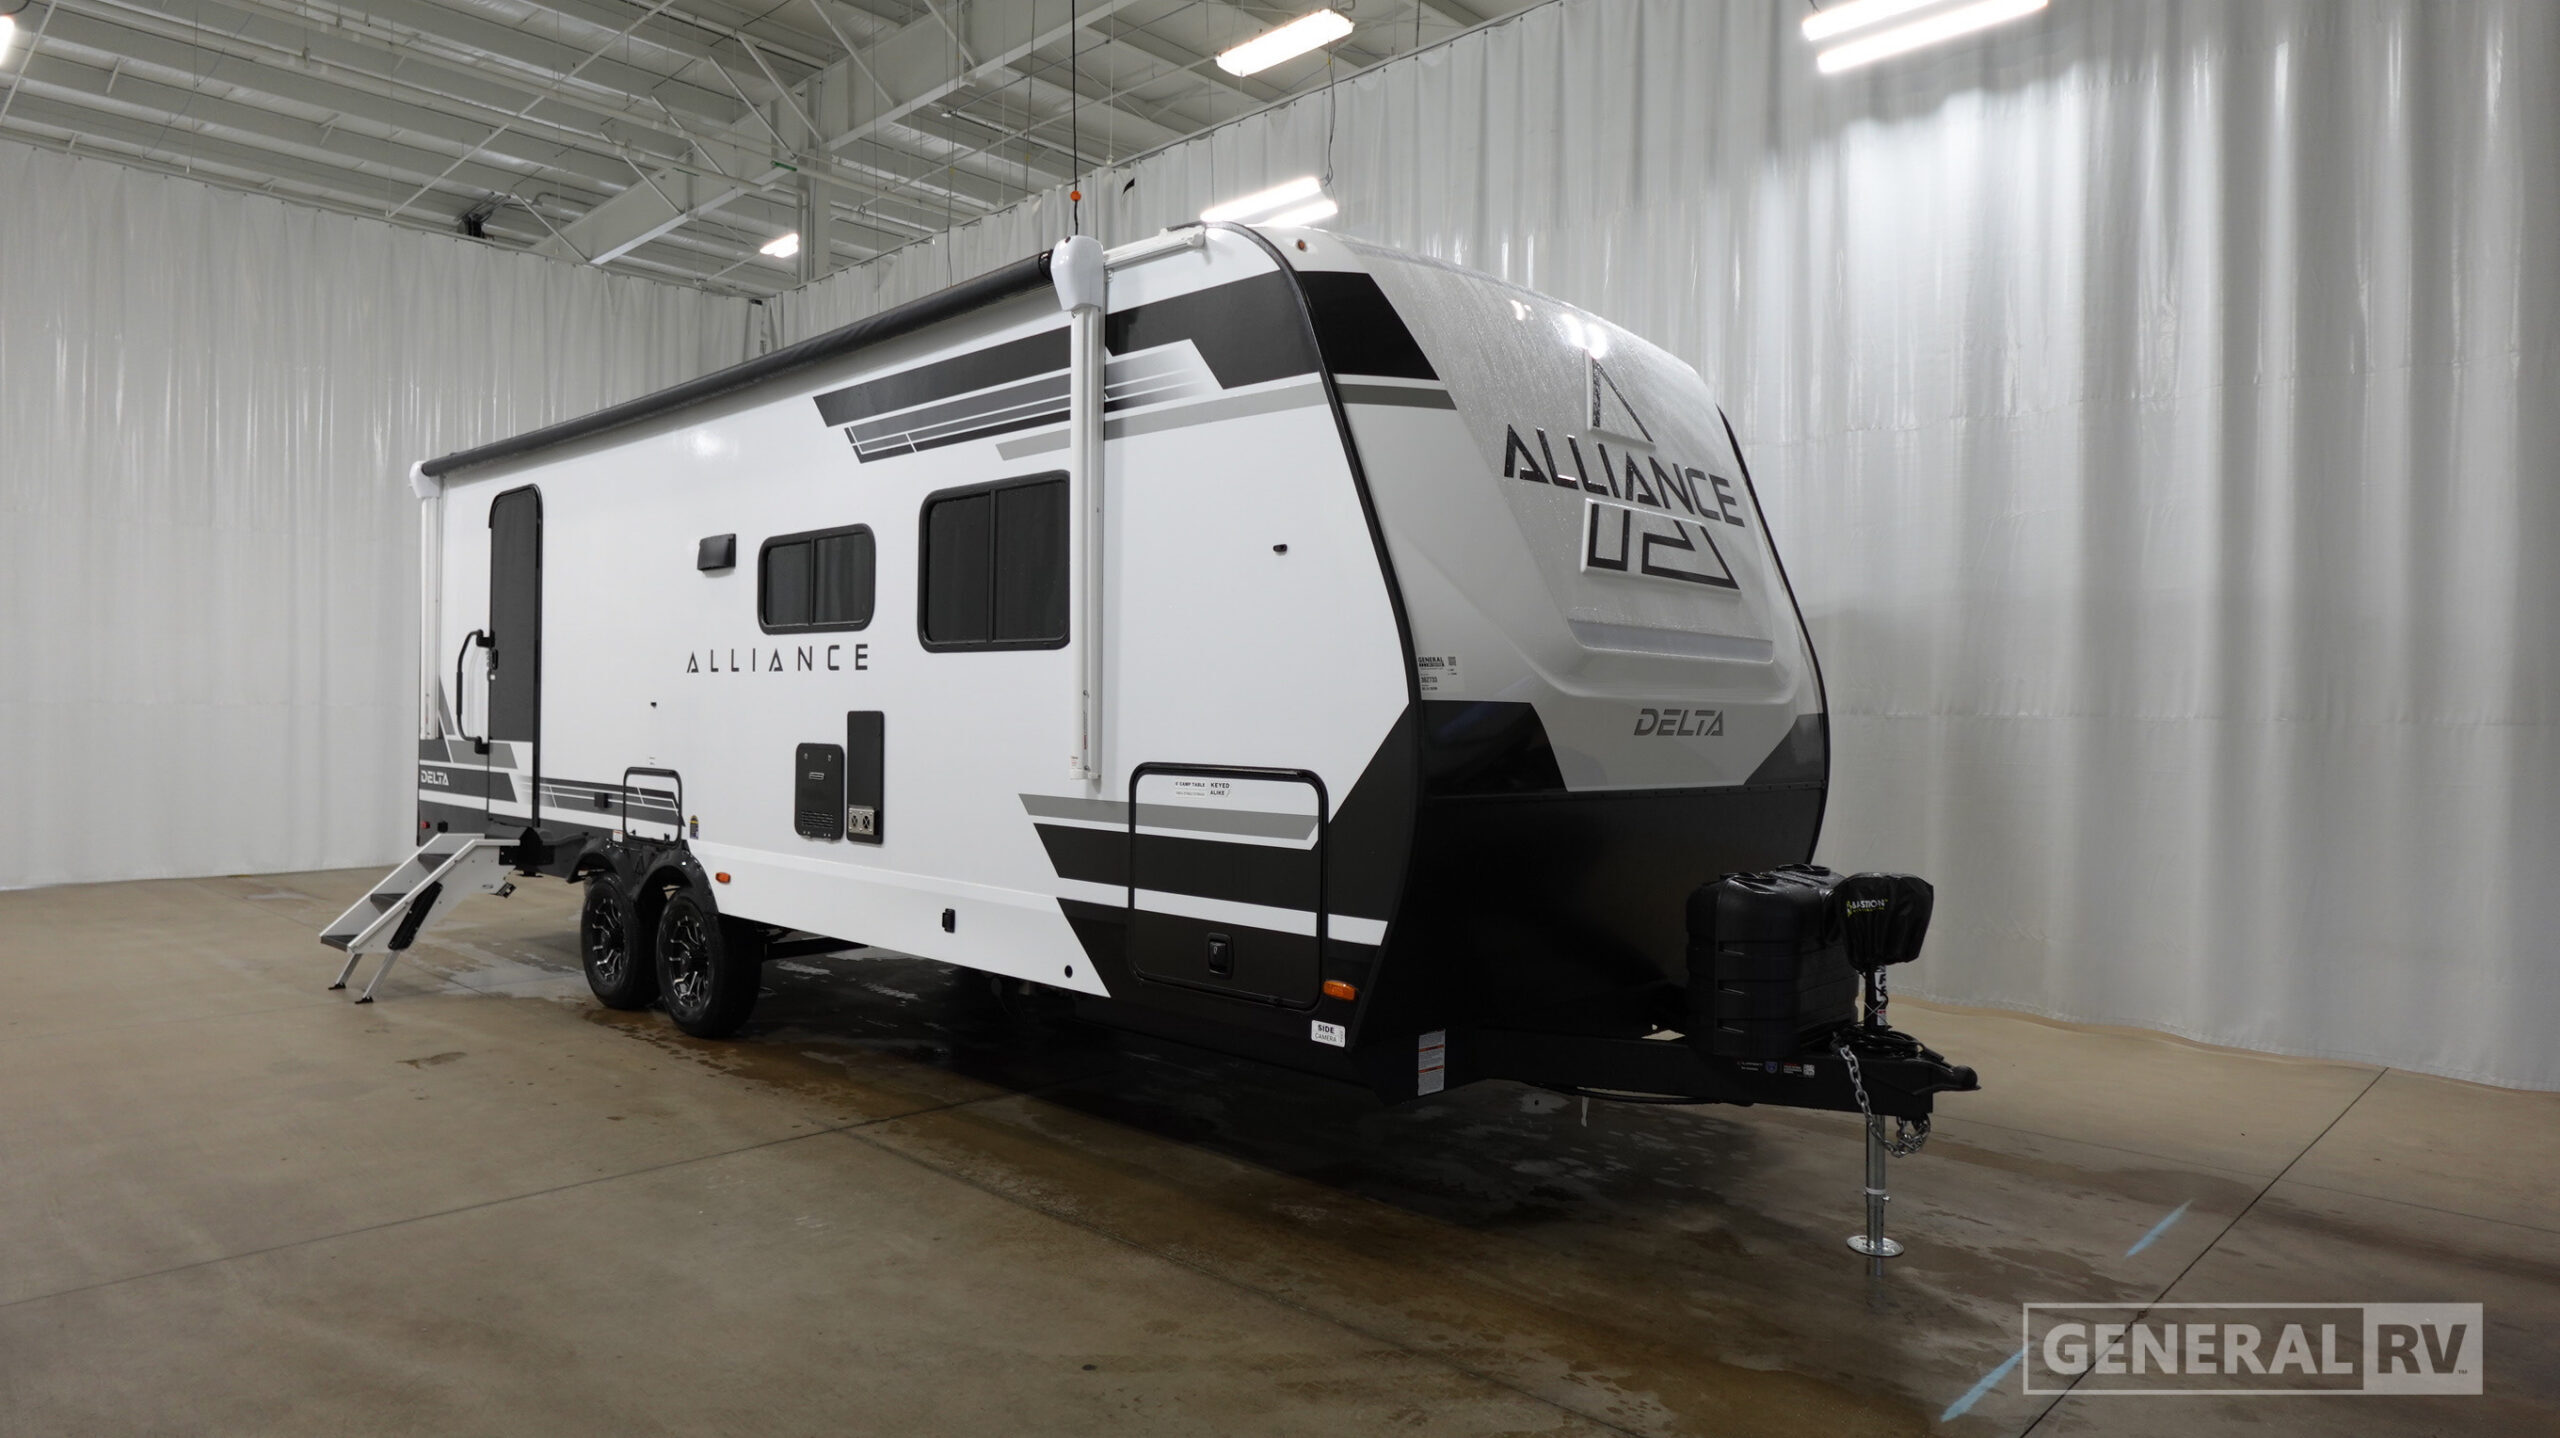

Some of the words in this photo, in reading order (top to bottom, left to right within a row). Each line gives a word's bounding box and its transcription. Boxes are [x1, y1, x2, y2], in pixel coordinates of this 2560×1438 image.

[1504, 424, 1745, 527] ALLIANCE
[686, 643, 868, 673] ALLIANCE
[1633, 708, 1724, 736] DELTA
[420, 769, 449, 786] DELTA
[1314, 1032, 1337, 1042] CAMERA
[1317, 1024, 1335, 1034] SIDE
